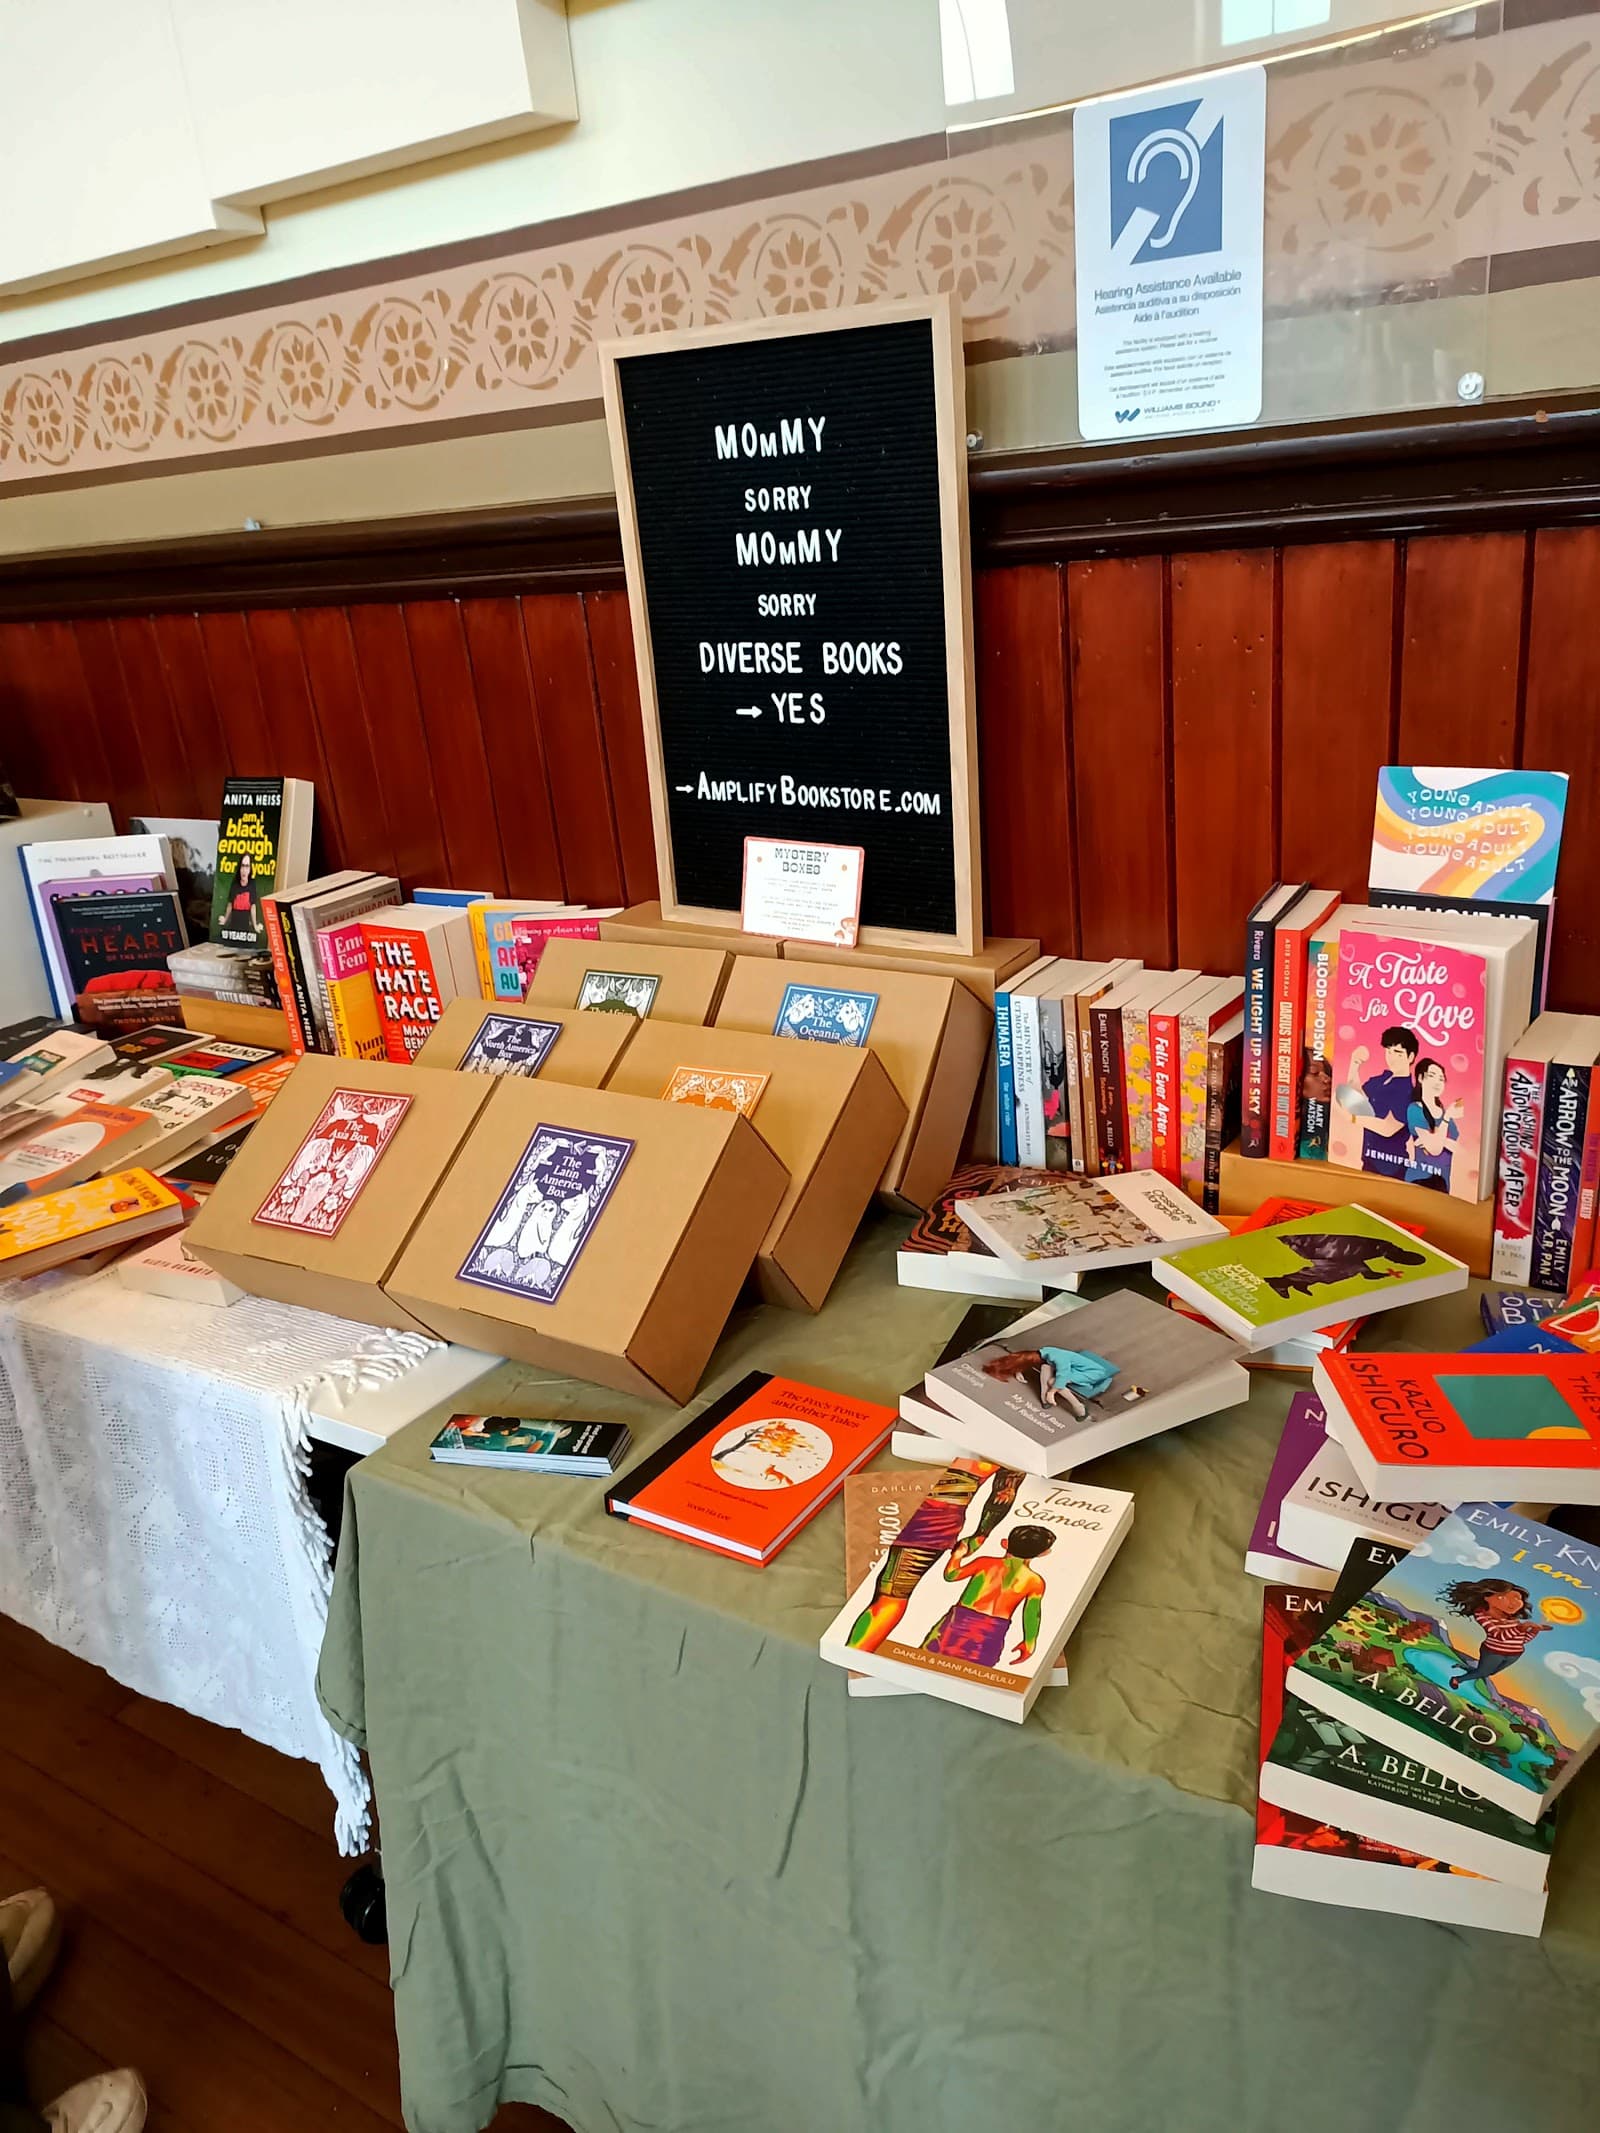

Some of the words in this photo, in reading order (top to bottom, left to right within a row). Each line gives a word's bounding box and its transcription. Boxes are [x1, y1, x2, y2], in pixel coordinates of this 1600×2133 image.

[1094, 286, 1133, 300] Hearing
[1136, 277, 1191, 295] Assistance
[1193, 269, 1241, 286] Available
[744, 485, 812, 512] SORRY
[757, 593, 817, 616] SORRY
[699, 642, 803, 674] DIVERSE
[822, 642, 903, 676] BOOKS
[771, 692, 826, 724] YES
[223, 794, 253, 806] ANITA
[255, 794, 281, 806] HEISS
[1407, 788, 1471, 806] YOUNG
[226, 818, 264, 838] black
[242, 812, 257, 823] am
[1406, 806, 1469, 823] YOUNG
[218, 834, 273, 861] enough
[219, 856, 238, 873] for
[251, 860, 276, 879] you?
[80, 930, 176, 954] HEART
[370, 941, 416, 966] THE
[1253, 930, 1264, 960] Rivera
[375, 968, 432, 994] HATE
[1251, 968, 1264, 990] WE
[1315, 952, 1328, 998] BLOOD
[1348, 962, 1374, 988] A
[1375, 951, 1449, 988] Taste
[296, 983, 307, 1016] ANITA
[302, 1017, 315, 1047] HEISS
[384, 996, 441, 1021] RACE
[1014, 1000, 1022, 1038] UTMOST
[1250, 993, 1263, 1034] LIGHT
[1279, 1002, 1292, 1036] DARIUS
[1359, 999, 1389, 1023] for
[1394, 988, 1475, 1047] Love
[799, 1026, 841, 1040] Oceania
[812, 1017, 832, 1028] The
[1098, 1013, 1108, 1039] EMILY
[1313, 1011, 1326, 1061] POISON
[506, 1035, 521, 1043] The
[506, 1043, 536, 1054] America
[997, 1006, 1011, 1067] IHIMAERA
[1024, 1024, 1033, 1070] MINISTRY
[1249, 1039, 1262, 1056] UP
[1278, 1038, 1291, 1055] THE
[1100, 1040, 1110, 1073] KNIGHT
[1155, 1036, 1169, 1067] Felix
[1016, 1040, 1025, 1093] HAPPINESS
[1249, 1060, 1262, 1083] THE
[1277, 1056, 1291, 1084] GREAT
[1155, 1072, 1170, 1100] Ever
[1530, 1086, 1541, 1102] THE
[1561, 1078, 1578, 1088] AN
[1248, 1088, 1261, 1115] SKY
[1510, 1071, 1536, 1150] ASTONISHING
[344, 1120, 361, 1133] The
[1155, 1102, 1170, 1136] After
[1308, 1098, 1317, 1133] WATSON
[1316, 1104, 1324, 1128] MARY
[1555, 1087, 1577, 1149] ARROW
[329, 1129, 350, 1142] Asia
[350, 1132, 369, 1144] Box
[1503, 1112, 1521, 1162] COLOUR
[562, 1156, 582, 1170] The
[1364, 1148, 1418, 1171] JENNIFER
[1419, 1161, 1443, 1176] YEN
[1552, 1154, 1573, 1165] THE
[1557, 1147, 1570, 1157] TO
[540, 1175, 583, 1192] America
[552, 1166, 579, 1181] Latin
[546, 1186, 567, 1199] Box
[1504, 1167, 1525, 1208] AFTER
[1548, 1166, 1570, 1217] MOON
[1152, 1189, 1184, 1214] Crossing
[1540, 1253, 1552, 1275] PAN
[1554, 1238, 1567, 1273] EMILY
[1232, 1264, 1263, 1287] James
[771, 1399, 794, 1409] and
[795, 1405, 830, 1418] Other
[830, 1414, 860, 1428] Tales
[781, 1391, 803, 1401] The
[833, 1406, 870, 1420] Tower
[1346, 1357, 1430, 1460] ISHIGURO
[1396, 1379, 1446, 1434] KAZUO
[871, 1483, 922, 1494] DAHLIA
[1043, 1486, 1113, 1515] Tama
[1014, 1500, 1104, 1532] Sāmoa
[1466, 1508, 1552, 1548] EMILY
[1532, 1563, 1592, 1589] am
[892, 1646, 928, 1664] DAHLIA
[928, 1656, 936, 1665] &
[937, 1658, 962, 1673] MANI
[964, 1665, 1017, 1686] MALAEULU
[1357, 1671, 1384, 1693] A.
[1395, 1689, 1497, 1746] BELLO
[1338, 1744, 1367, 1766] A.
[1336, 1763, 1369, 1777] wonderful
[1427, 1790, 1443, 1801] help
[1367, 1780, 1409, 1796] KATHERINE
[1411, 1791, 1441, 1806] WEBBER
